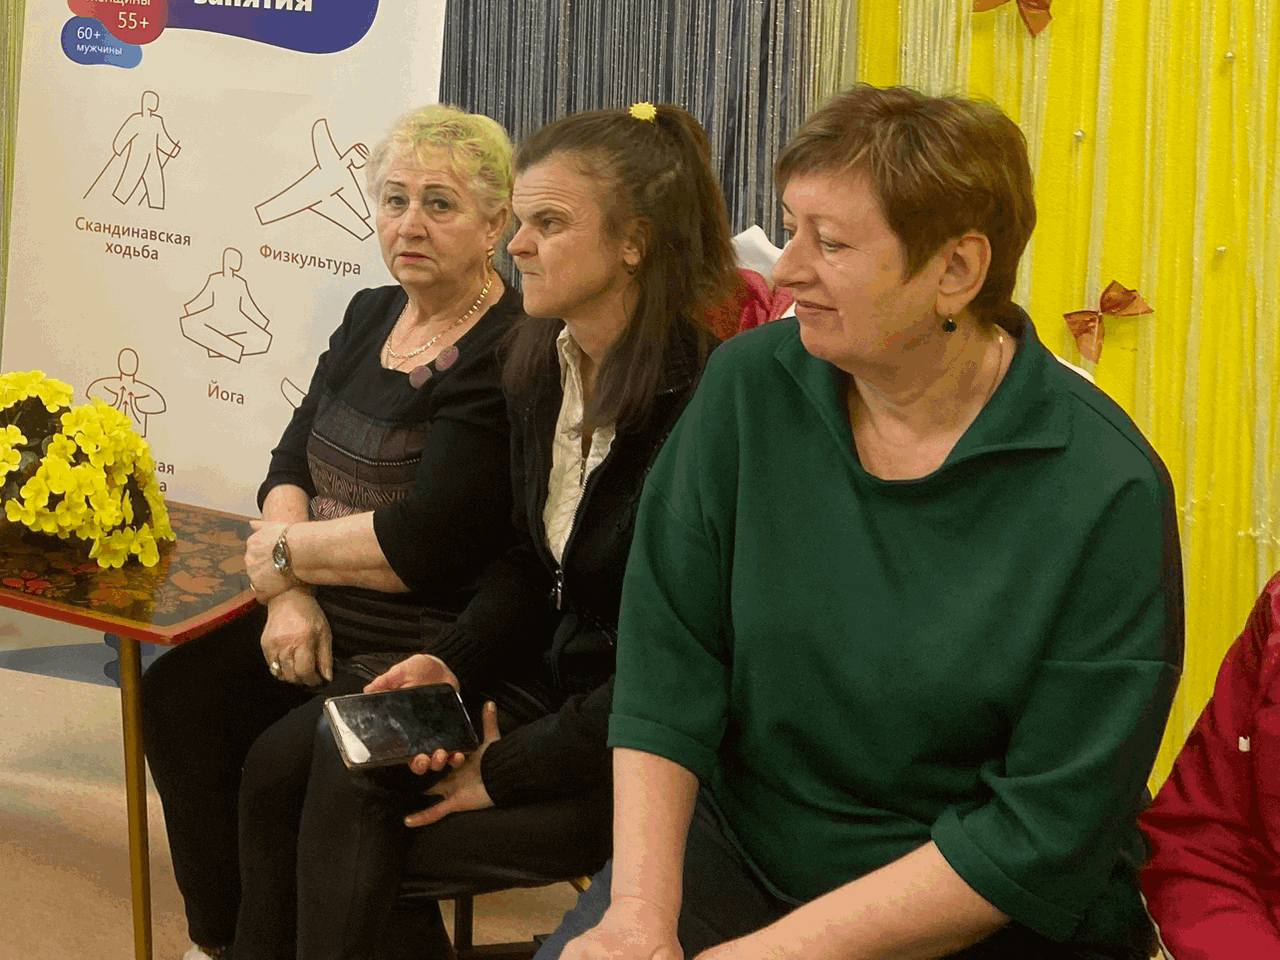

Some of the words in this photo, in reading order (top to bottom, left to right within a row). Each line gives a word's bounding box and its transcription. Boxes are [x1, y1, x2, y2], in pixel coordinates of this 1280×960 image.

[117, 12, 150, 30] 55+
[76, 26, 101, 41] 60+
[76, 44, 123, 57] мужчины
[75, 216, 191, 246] Скандинавская
[105, 242, 159, 261] ходьба
[259, 244, 361, 276] Физкультура
[207, 379, 245, 405] Йога
